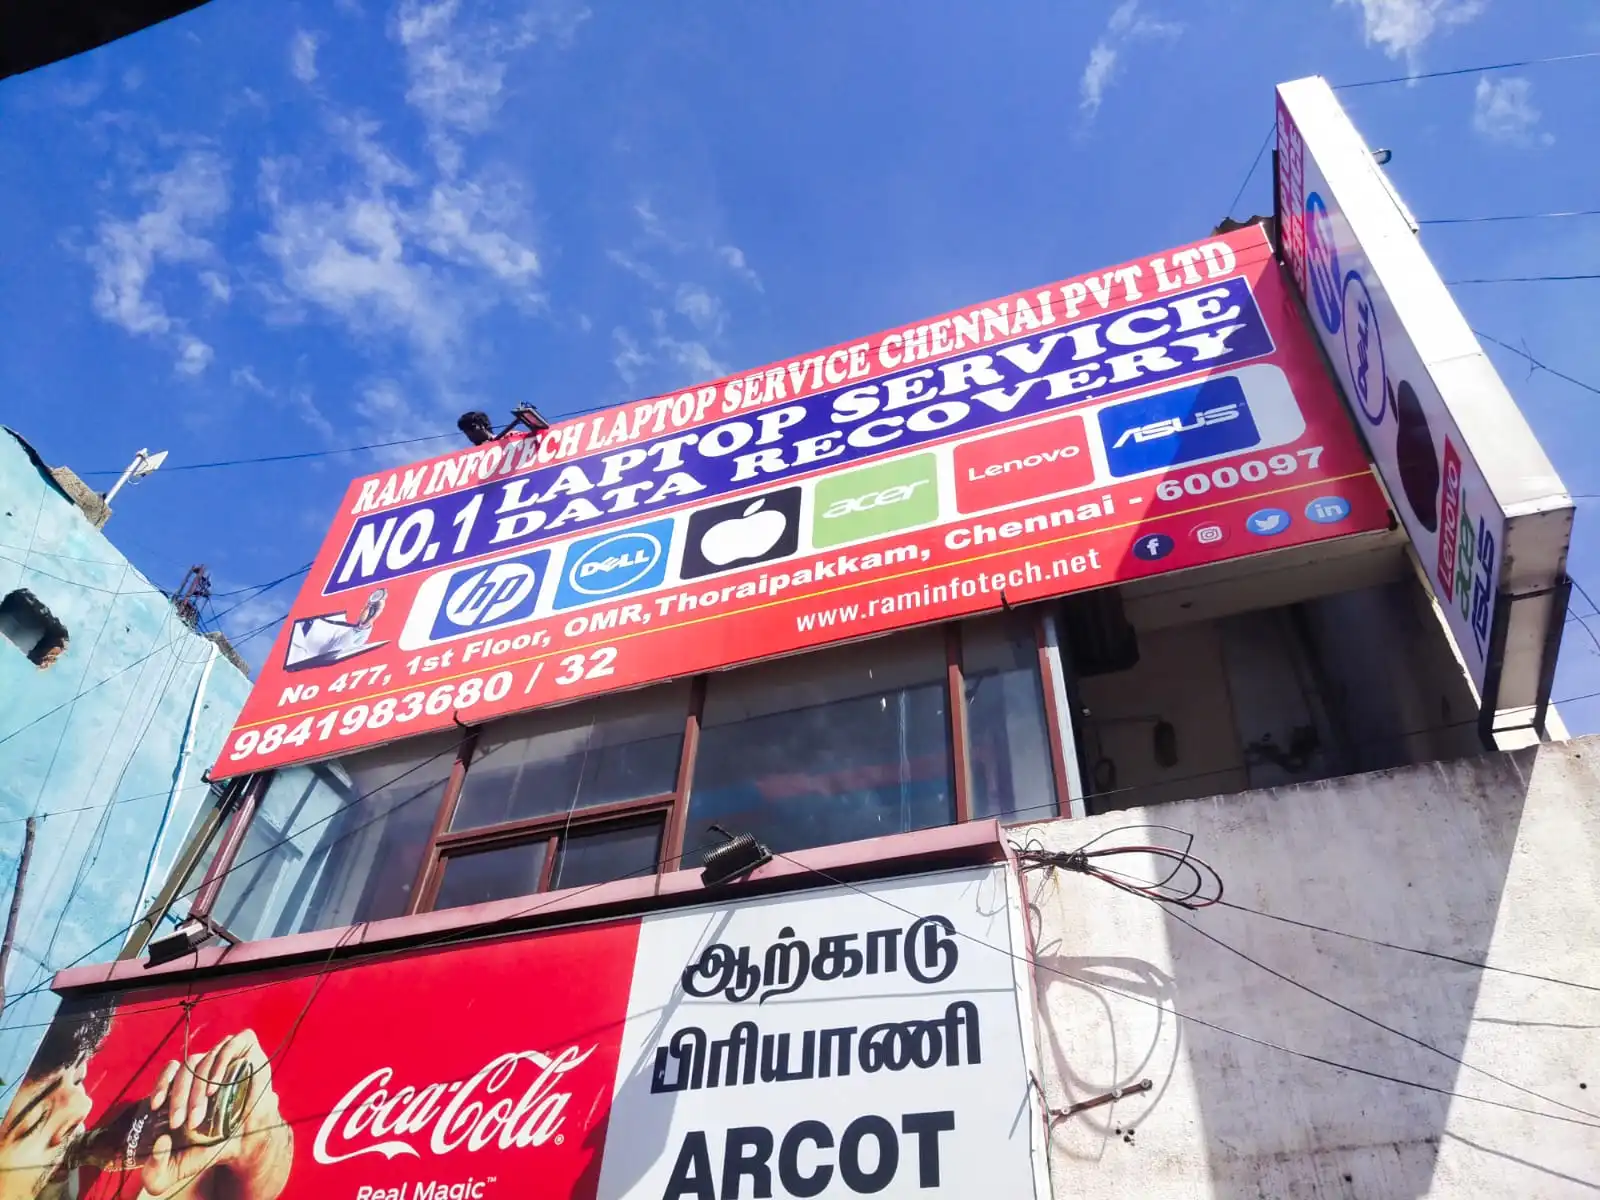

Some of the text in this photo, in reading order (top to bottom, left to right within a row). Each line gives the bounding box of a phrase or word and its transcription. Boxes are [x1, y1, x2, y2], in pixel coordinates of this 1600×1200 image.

[351, 241, 1236, 514] RAM INFOTECH LAPTOP SERVICE CHENNAI PVT LTD
[495, 287, 1241, 514] LAPTOP SERVICE
[1357, 301, 1369, 403] DELL
[489, 323, 1247, 544] DATA RECOVERY
[968, 446, 1080, 481] Lenovo
[1112, 403, 1240, 448] ASUS
[822, 480, 930, 519] acer
[1439, 461, 1459, 587] Lenovo
[278, 684, 319, 706] No
[327, 664, 392, 694] 477,
[406, 648, 455, 677] 1st
[461, 629, 551, 662] Floor,
[944, 494, 1116, 551] Chennai
[1156, 446, 1324, 502] 600097
[449, 563, 531, 626] hp
[580, 550, 650, 578] DELL
[796, 548, 1102, 633] www.raminfotech.net
[1456, 488, 1475, 622] acer
[1472, 515, 1495, 663] ASUS
[229, 647, 618, 762] 9841983680 / 32
[681, 914, 958, 1007] ஆற்காடு
[650, 1001, 981, 1094] பிரியாணி
[313, 1042, 600, 1165] Coca-Cola
[356, 1182, 408, 1200] Real
[662, 1110, 955, 1200] ARCOT
